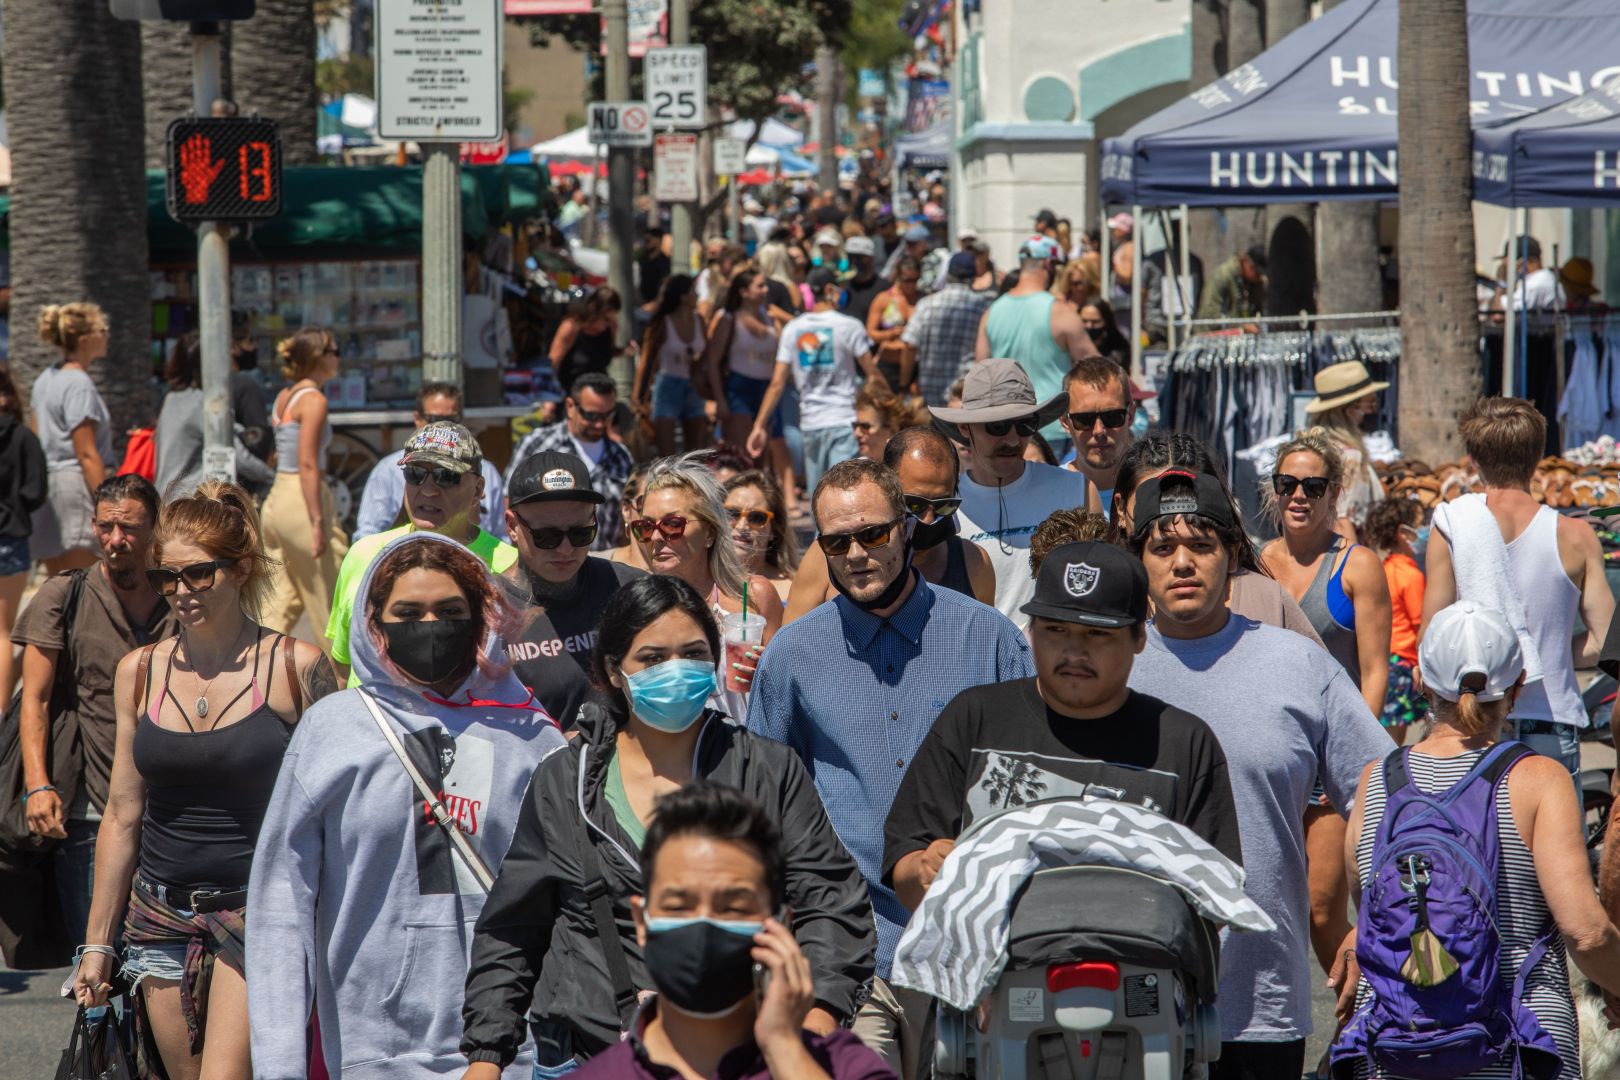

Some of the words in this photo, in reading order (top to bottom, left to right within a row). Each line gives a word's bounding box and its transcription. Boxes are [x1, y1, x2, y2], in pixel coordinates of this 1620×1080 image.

[649, 53, 699, 67] SPEED
[653, 72, 694, 85] LIMIT
[655, 91, 697, 119] 25
[592, 107, 619, 130] NO
[239, 141, 272, 202] 13
[1069, 567, 1096, 576] RAIDERS
